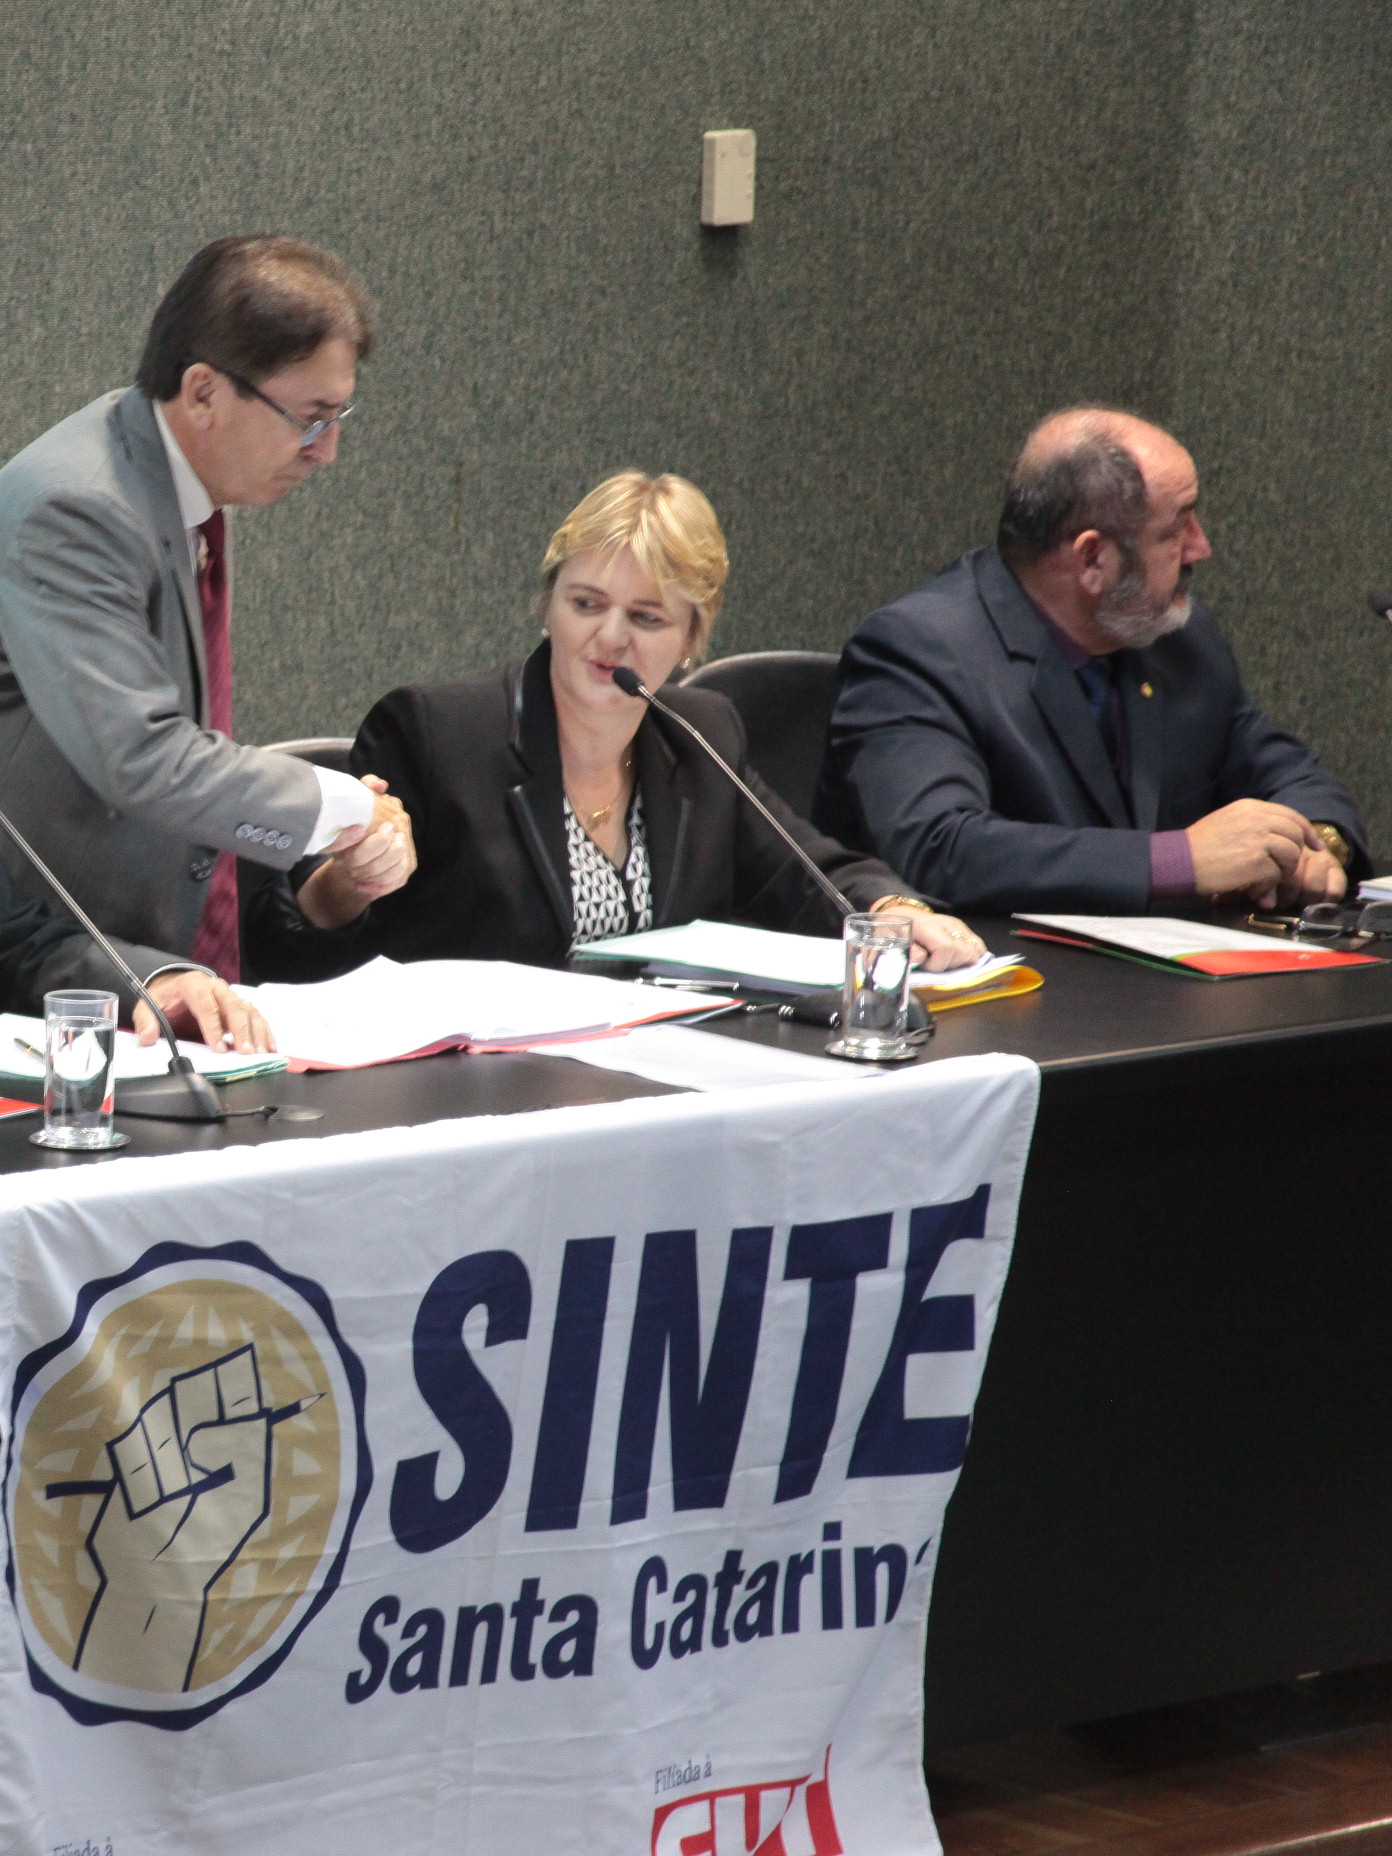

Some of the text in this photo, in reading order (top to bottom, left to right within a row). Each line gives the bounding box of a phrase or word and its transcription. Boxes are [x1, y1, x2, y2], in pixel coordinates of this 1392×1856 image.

[390, 1183, 991, 1552] SINTE
[345, 1521, 931, 1705] Santa Catarin
[654, 1759, 701, 1794] Filiada
